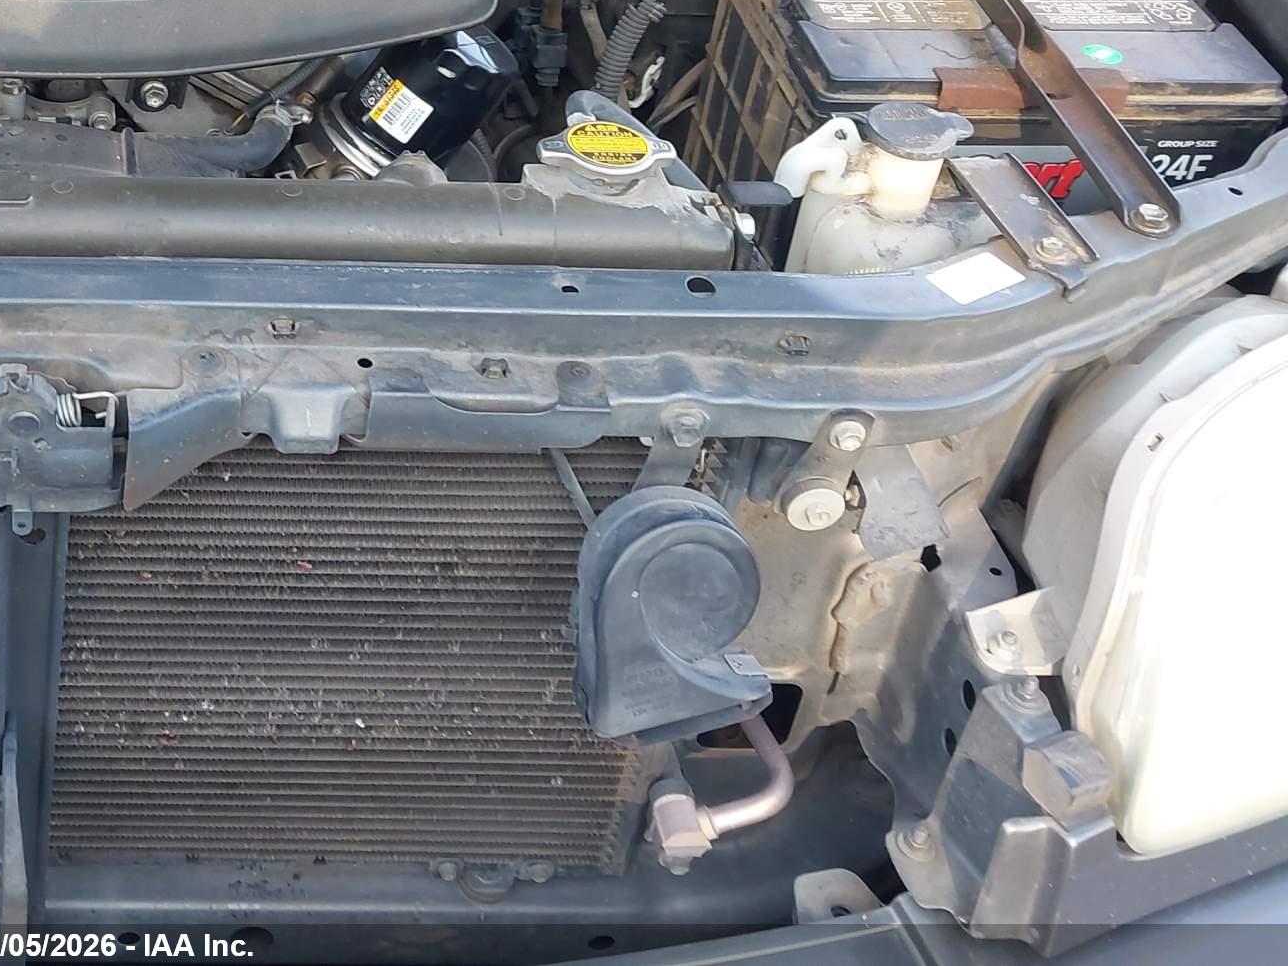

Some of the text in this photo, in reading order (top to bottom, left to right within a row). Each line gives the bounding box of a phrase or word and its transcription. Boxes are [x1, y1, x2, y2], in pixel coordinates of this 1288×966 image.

[577, 130, 634, 138] CAUTION
[1157, 140, 1219, 148] GROUP SIZE
[1152, 154, 1214, 181] 24F
